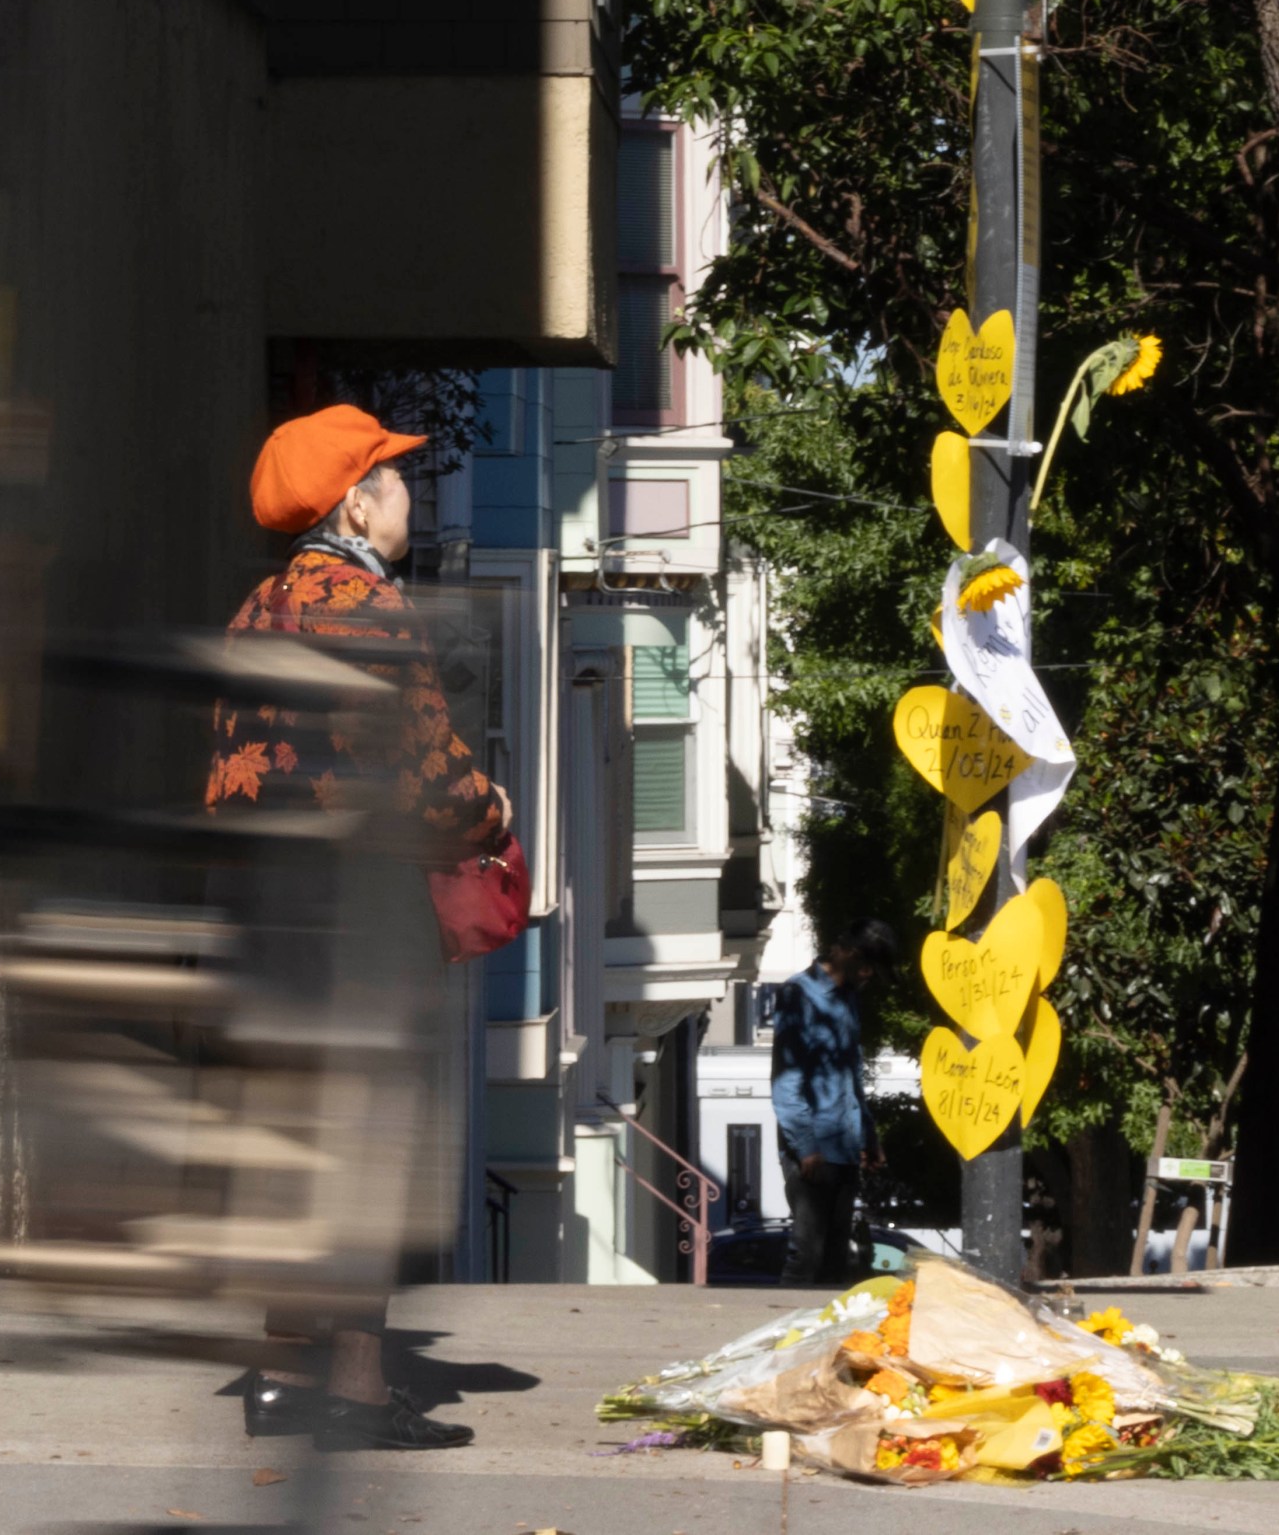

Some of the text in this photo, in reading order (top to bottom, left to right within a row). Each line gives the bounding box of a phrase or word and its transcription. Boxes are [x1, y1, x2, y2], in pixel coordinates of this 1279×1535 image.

[925, 745, 1015, 785] 2/05/24
[941, 948, 997, 981] Person
[959, 965, 1024, 1012] 1/31/24
[938, 1089, 1000, 1126] 8/15/24
